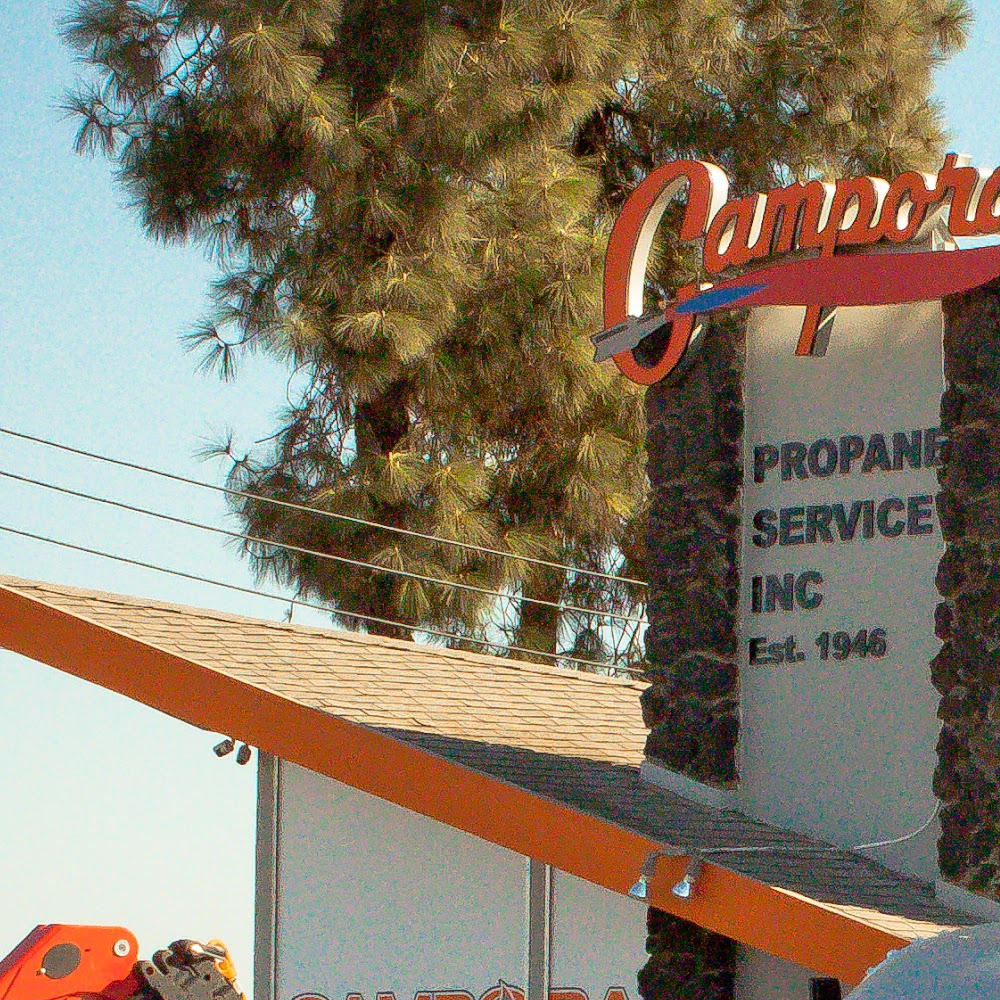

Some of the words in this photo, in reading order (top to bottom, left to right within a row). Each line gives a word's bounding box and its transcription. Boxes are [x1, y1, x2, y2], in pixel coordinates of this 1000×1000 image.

[752, 494, 934, 548] SERVICE
[752, 570, 824, 613] INC
[749, 635, 806, 666] Est.
[815, 627, 888, 661] 1946
